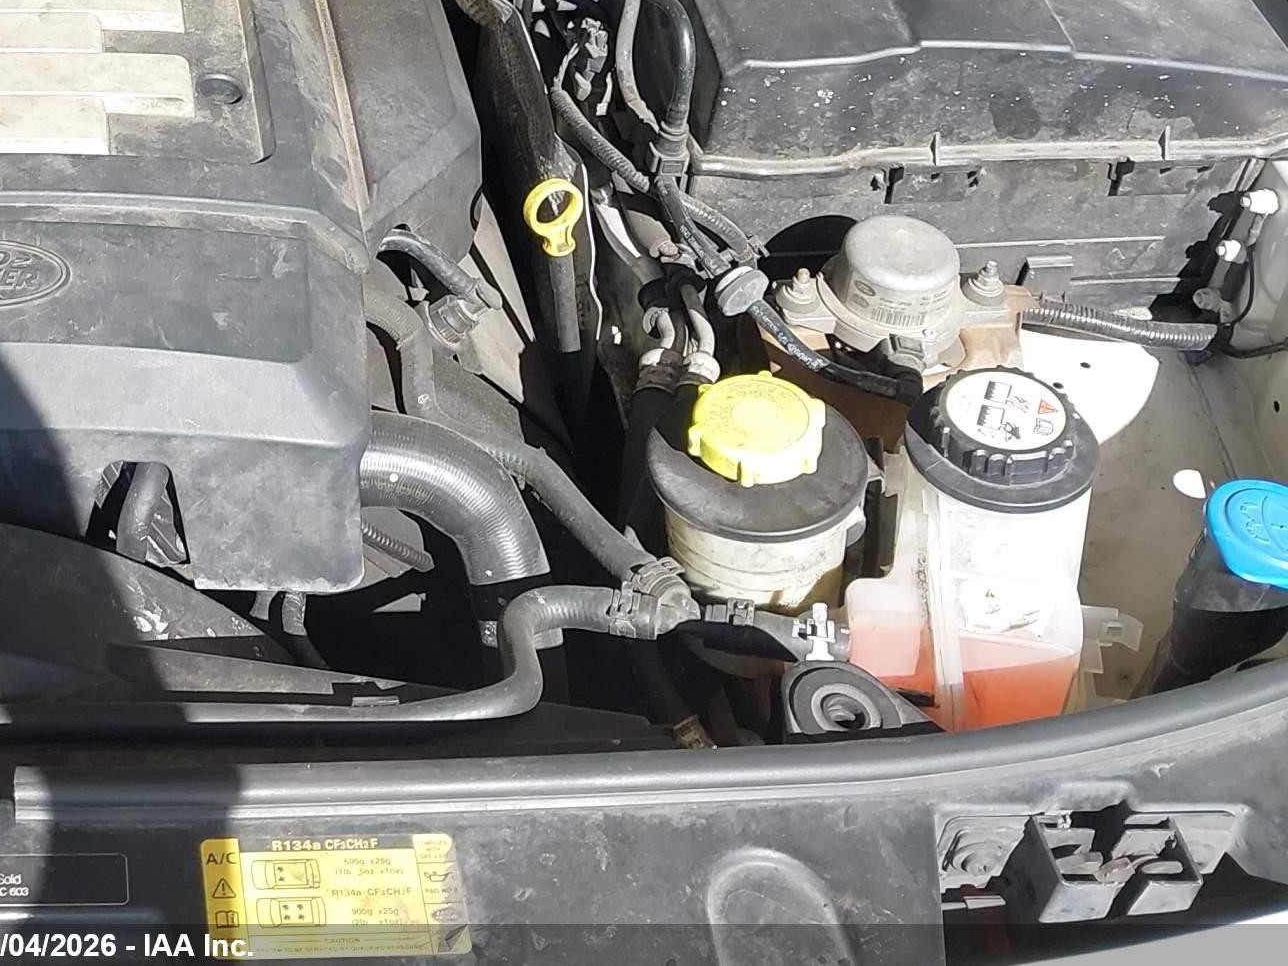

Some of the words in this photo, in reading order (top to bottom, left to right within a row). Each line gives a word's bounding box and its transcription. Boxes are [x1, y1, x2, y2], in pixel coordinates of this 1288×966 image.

[272, 840, 321, 852] R134a
[206, 852, 237, 865] A/C
[9, 887, 29, 897] 603
